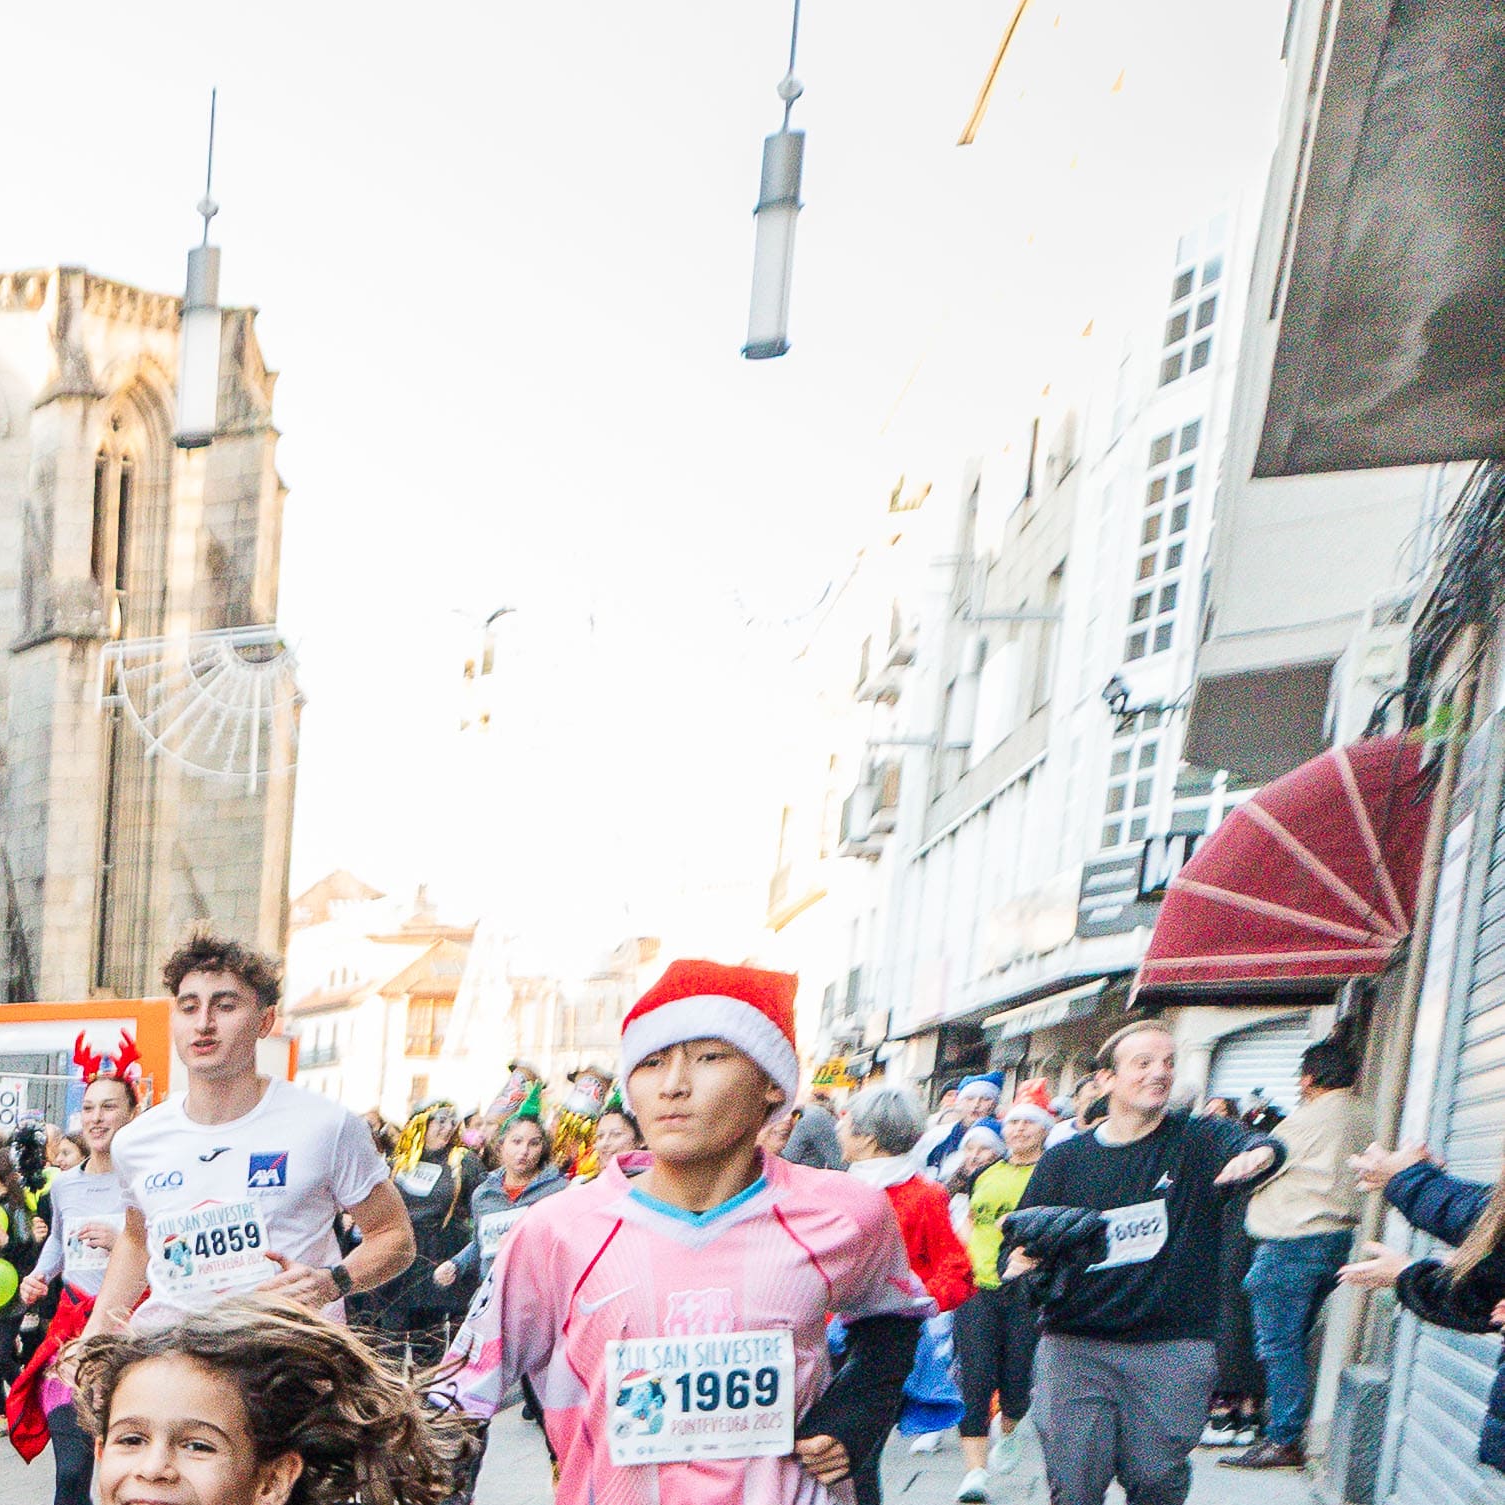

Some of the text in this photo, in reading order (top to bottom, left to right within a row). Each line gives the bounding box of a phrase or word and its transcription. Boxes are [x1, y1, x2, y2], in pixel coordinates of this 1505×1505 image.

[248, 1167, 282, 1187] AXA
[177, 1212, 200, 1234] SAN
[202, 1201, 256, 1226] SILVESTRE
[195, 1220, 262, 1259] 4859
[615, 1335, 784, 1371] XLII SAN SILVESTRE
[675, 1366, 780, 1413] 1969
[670, 1411, 784, 1436] PONTEVEDRA 2025
